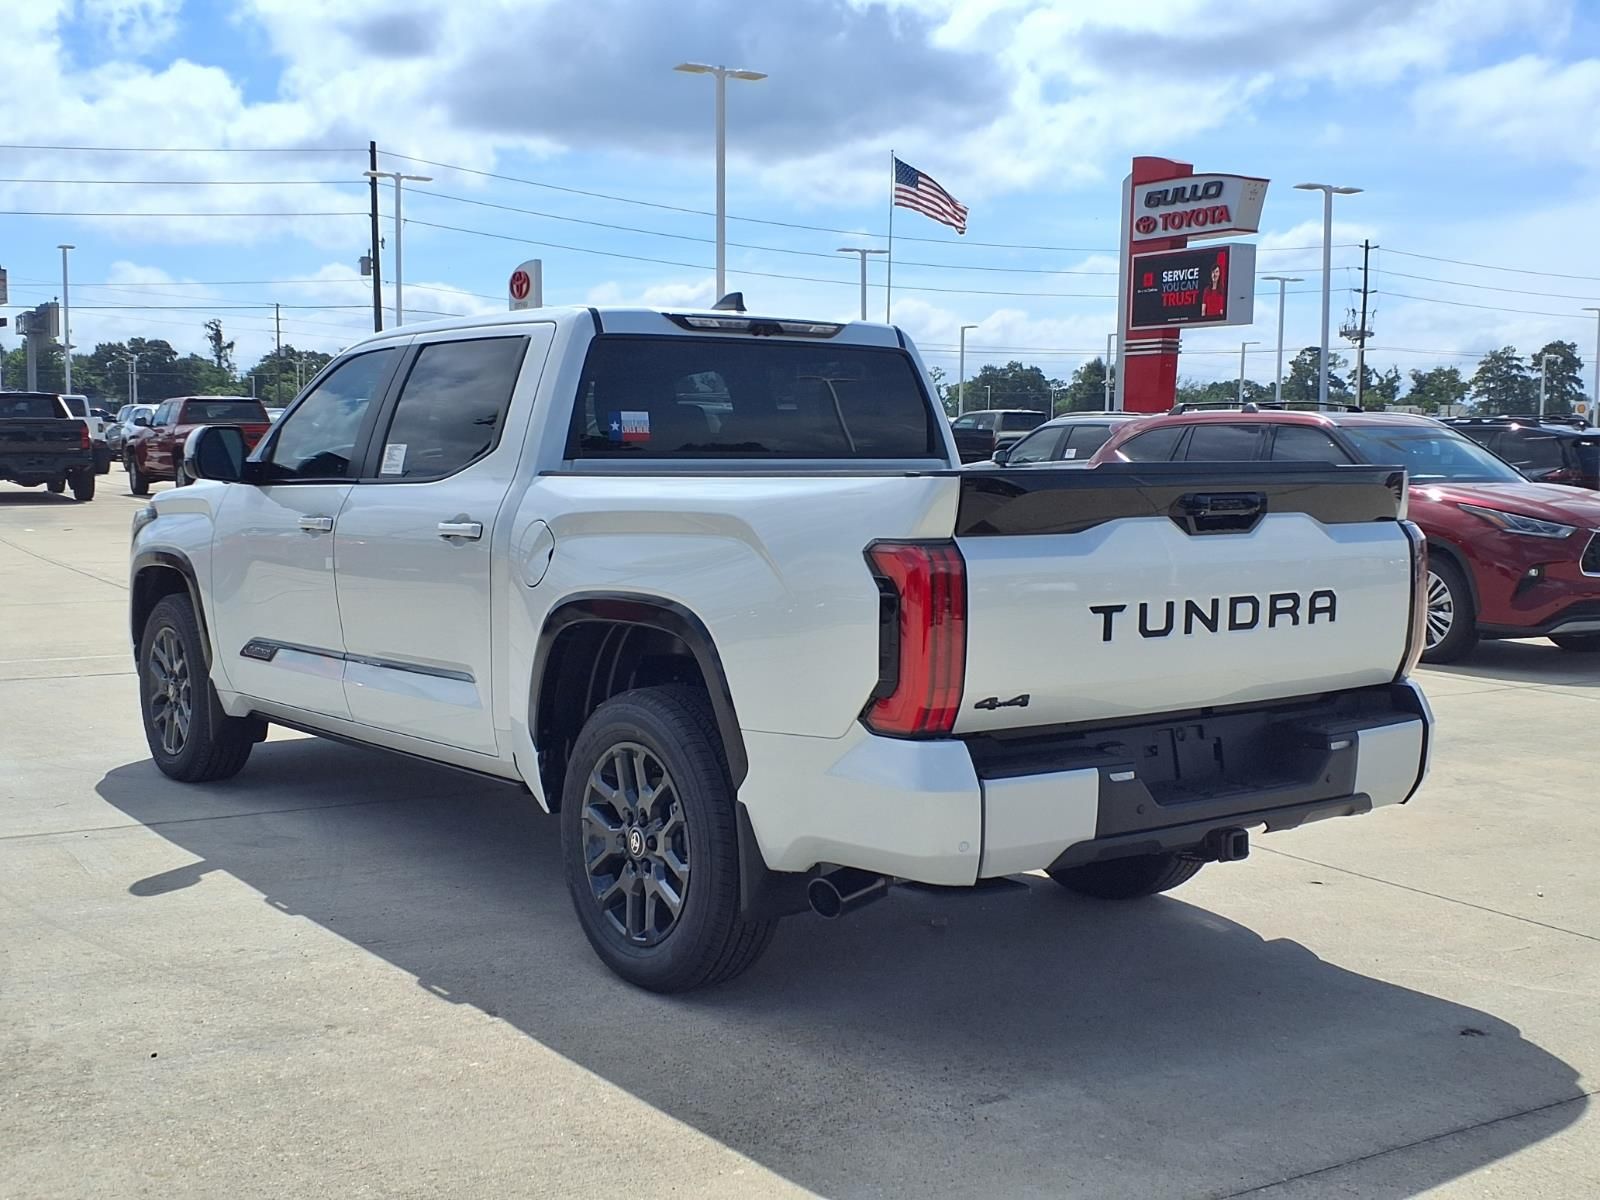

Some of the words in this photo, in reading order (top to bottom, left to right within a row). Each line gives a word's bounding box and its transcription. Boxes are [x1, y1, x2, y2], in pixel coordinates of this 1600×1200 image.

[1144, 181, 1224, 208] GULLO
[1159, 205, 1232, 231] TOYOTA
[1162, 268, 1200, 282] SERVICE
[1162, 282, 1180, 292] YOU
[1180, 280, 1198, 290] CAN
[1162, 290, 1199, 306] TRUST
[1089, 589, 1337, 642] TUNDRA
